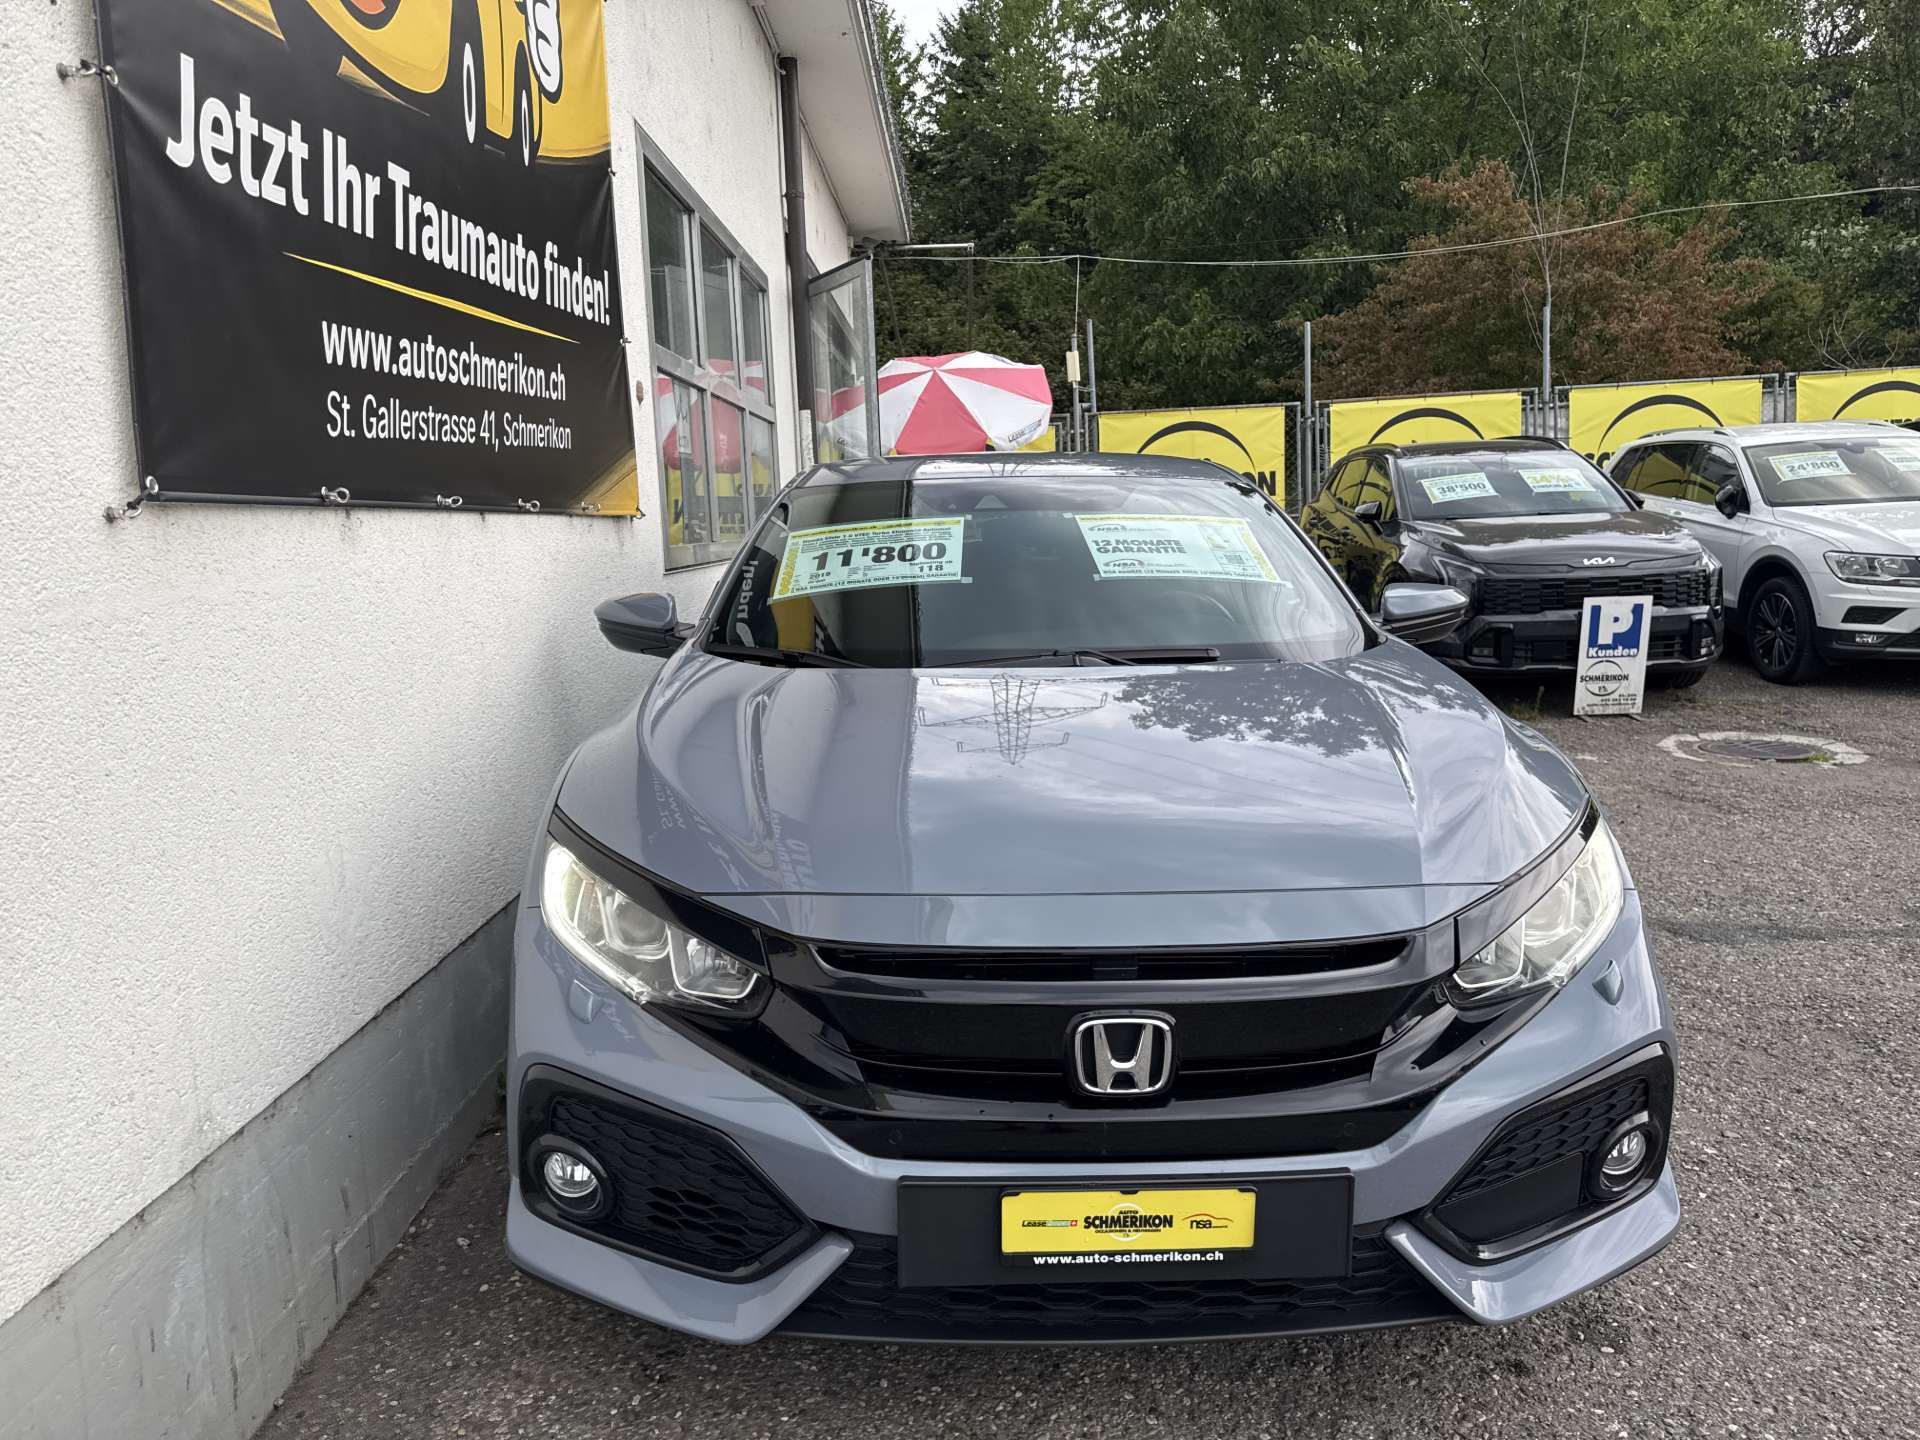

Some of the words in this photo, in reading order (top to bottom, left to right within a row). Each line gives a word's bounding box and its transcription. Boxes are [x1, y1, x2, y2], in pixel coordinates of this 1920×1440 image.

[166, 52, 309, 216] Jetzt
[322, 128, 381, 239] Ihr
[387, 161, 539, 301] Traumauto
[544, 240, 610, 325] finden!
[321, 320, 566, 402] www.autoschmerikon.ch
[326, 391, 356, 439] St.
[362, 393, 476, 444] Gallerstrasse
[480, 410, 499, 452] 41,
[504, 413, 572, 449] Schmerikon
[1786, 460, 1841, 473] 24'800
[1437, 482, 1486, 495] 38'500
[1091, 539, 1114, 547] 12
[1115, 538, 1184, 547] MONATE
[812, 542, 947, 571] 11'800
[1096, 546, 1187, 554] GARANTIE
[918, 564, 944, 573] 118
[1597, 602, 1634, 645] P
[1588, 646, 1638, 658] Kunden
[1579, 674, 1630, 683] SCHMERIKON
[1083, 1215, 1174, 1230] SCHMERIKON
[1189, 1219, 1212, 1229] nsa
[1033, 1251, 1224, 1265] www.auto-schmerikon.ch
